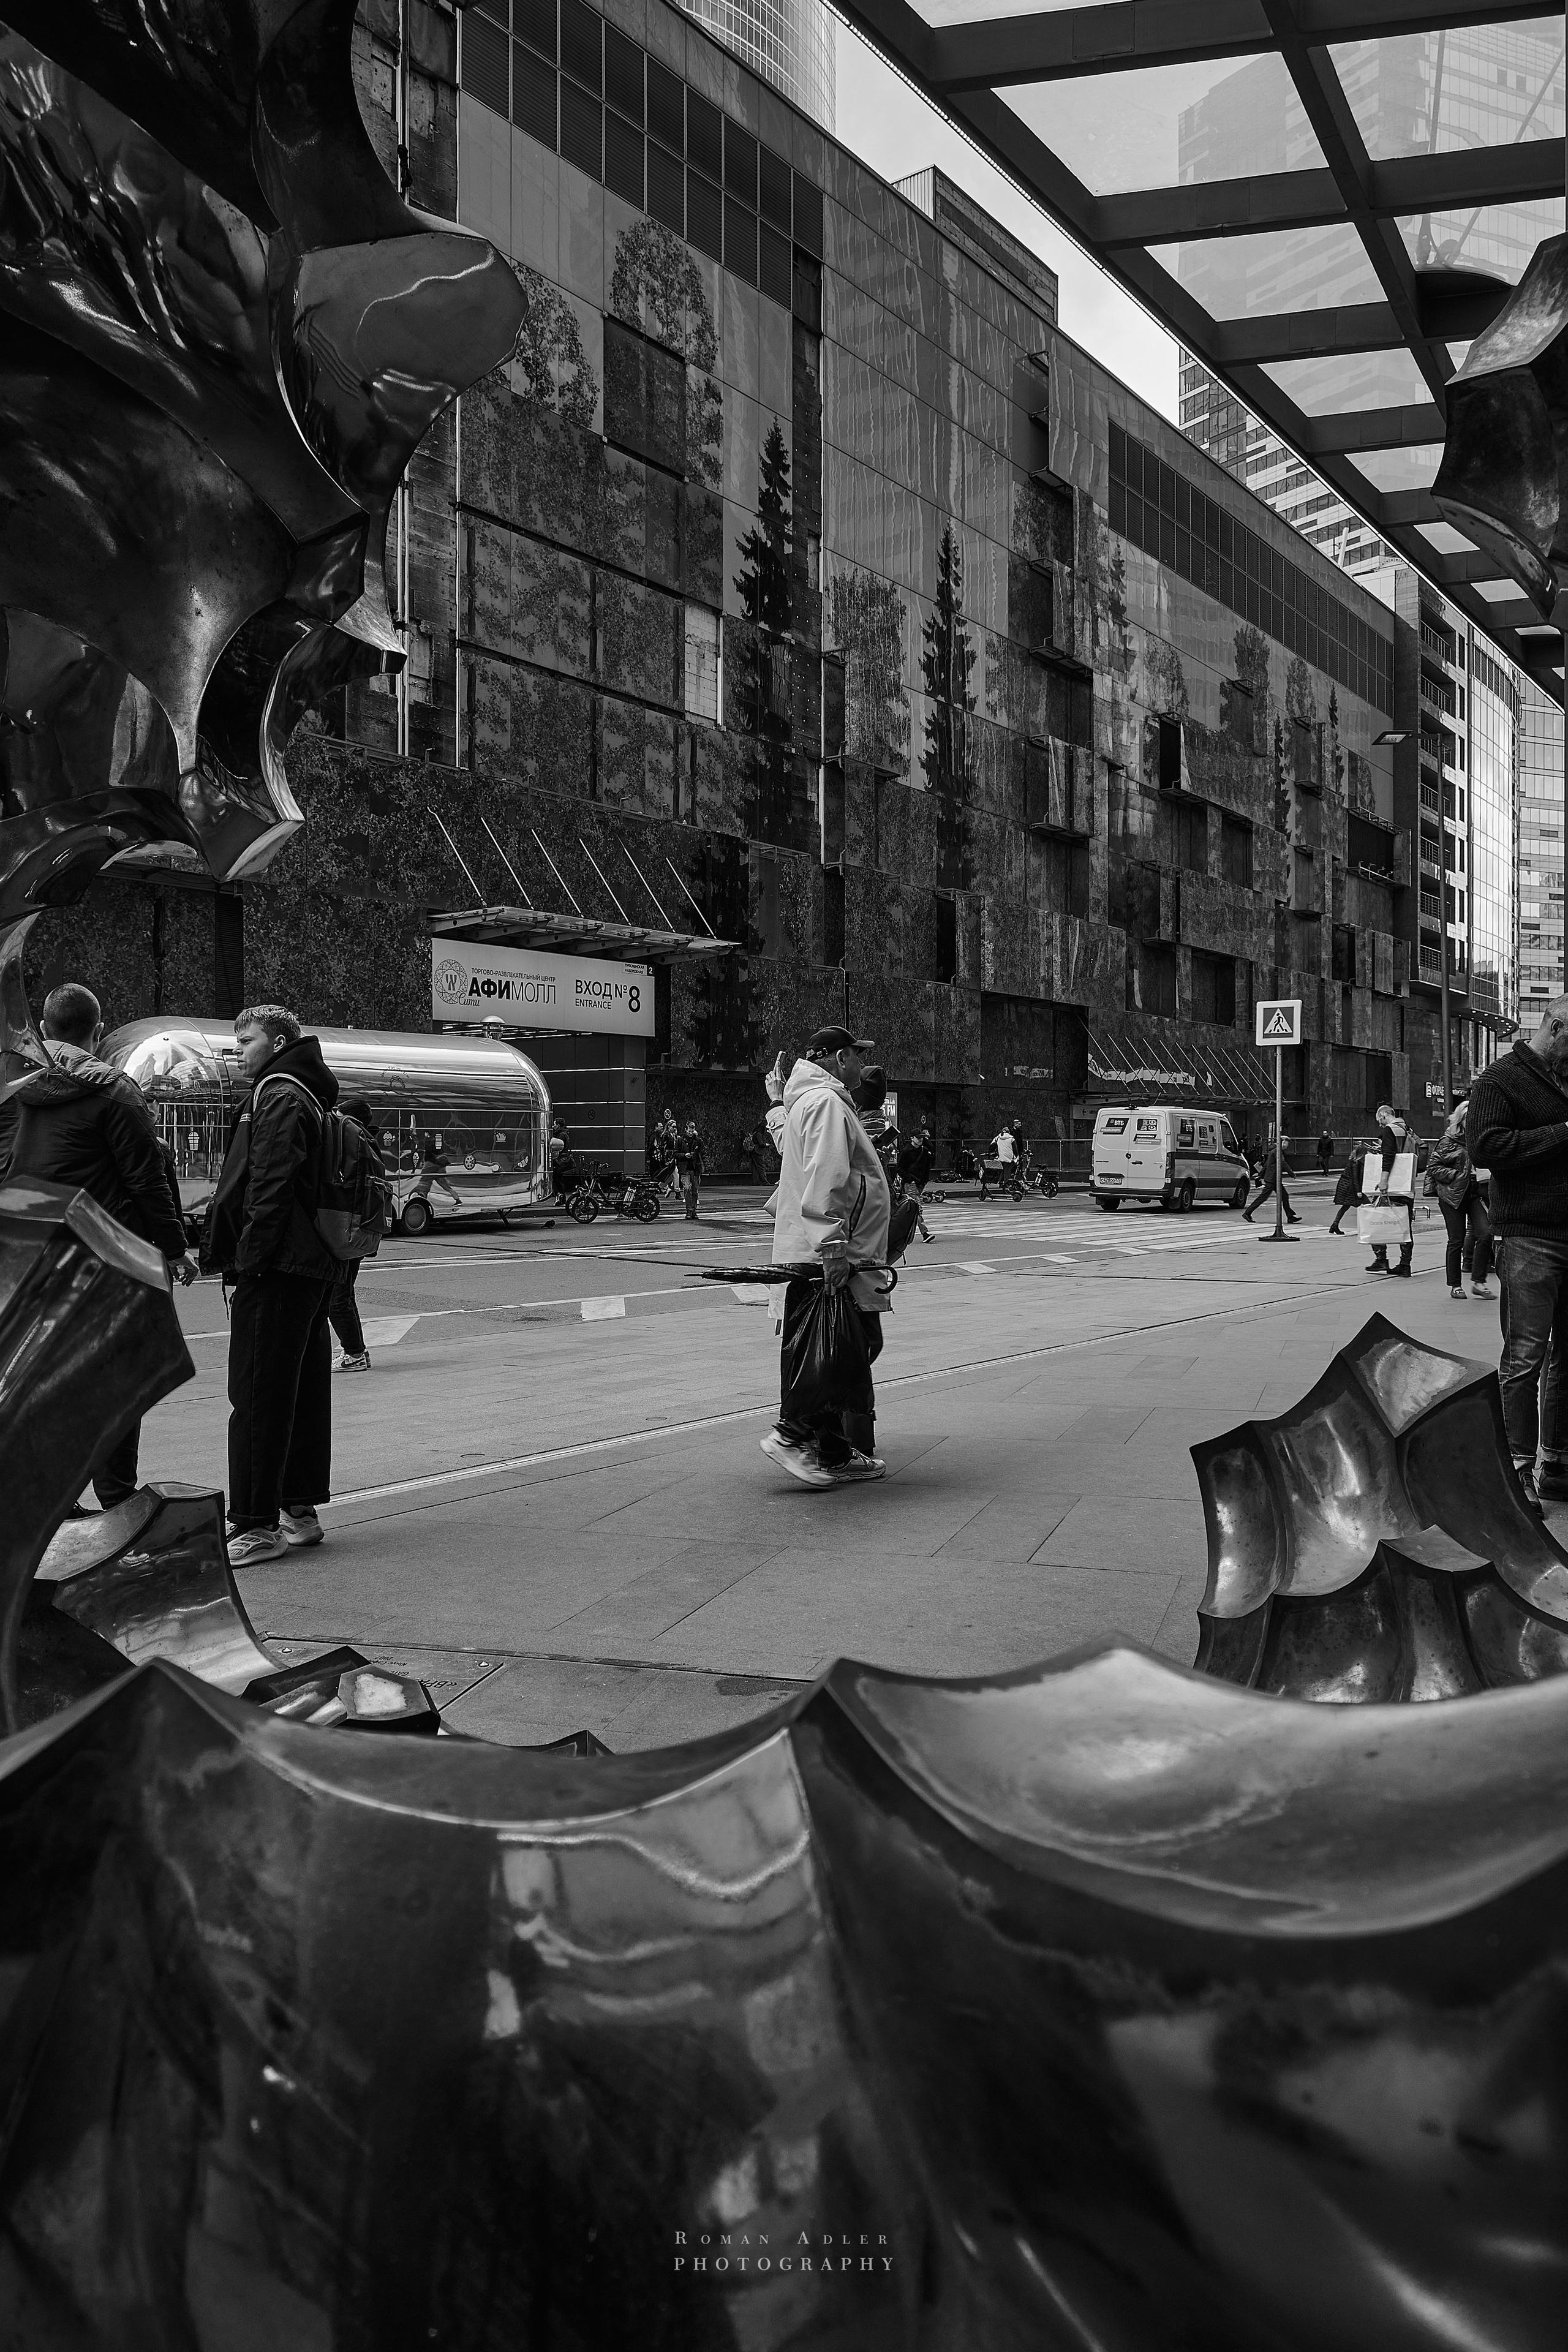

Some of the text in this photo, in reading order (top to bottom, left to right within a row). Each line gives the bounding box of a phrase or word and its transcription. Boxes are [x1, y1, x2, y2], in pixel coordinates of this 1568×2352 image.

[471, 968, 541, 981] ТОРГОВО-РАЗВЛЕКАТЕЛЬНЫЙ
[468, 977, 556, 1004] АФИМОЛЛ
[575, 979, 612, 1000] ВХОД
[456, 990, 480, 1007] Сити
[575, 998, 611, 1009] ENTRANCE
[887, 1104, 895, 1116] FM
